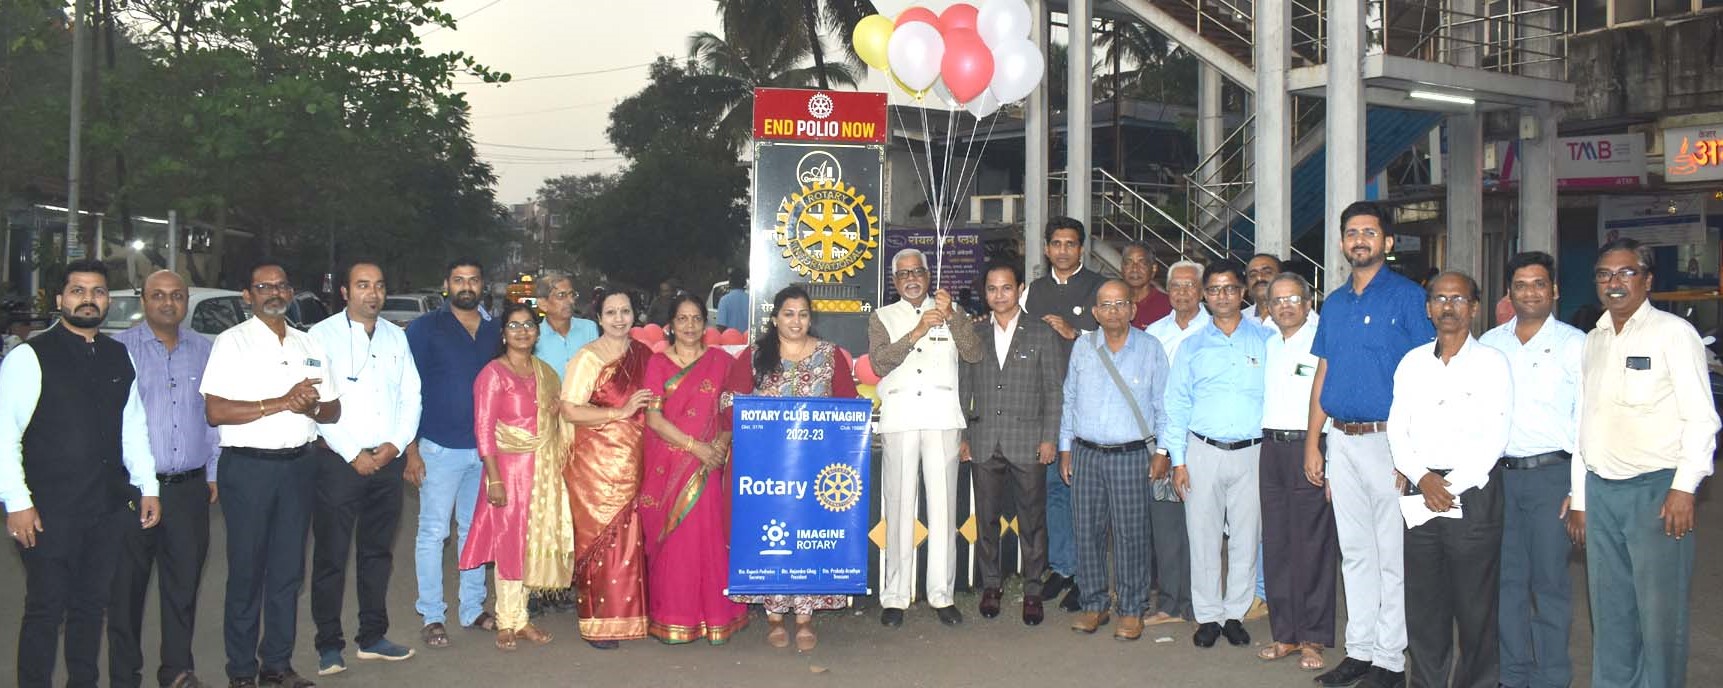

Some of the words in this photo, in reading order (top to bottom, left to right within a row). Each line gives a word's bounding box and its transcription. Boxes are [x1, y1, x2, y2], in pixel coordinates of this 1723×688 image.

[764, 118, 794, 136] END
[796, 119, 839, 137] POLIO
[841, 121, 876, 138] NOW
[1566, 140, 1612, 161] TMB
[807, 190, 850, 203] ROTARY
[908, 232, 935, 246] रॉयल
[957, 235, 979, 246] प्लश
[789, 241, 864, 271] INTERNATIONAL
[741, 409, 780, 421] ROTARY
[783, 410, 810, 421] CLUB
[812, 410, 866, 422] RATNAGIRI
[786, 428, 824, 441] 2022-23
[739, 476, 808, 499] Rotary
[796, 529, 845, 539] IMAGINE
[796, 540, 838, 550] ROTARY
